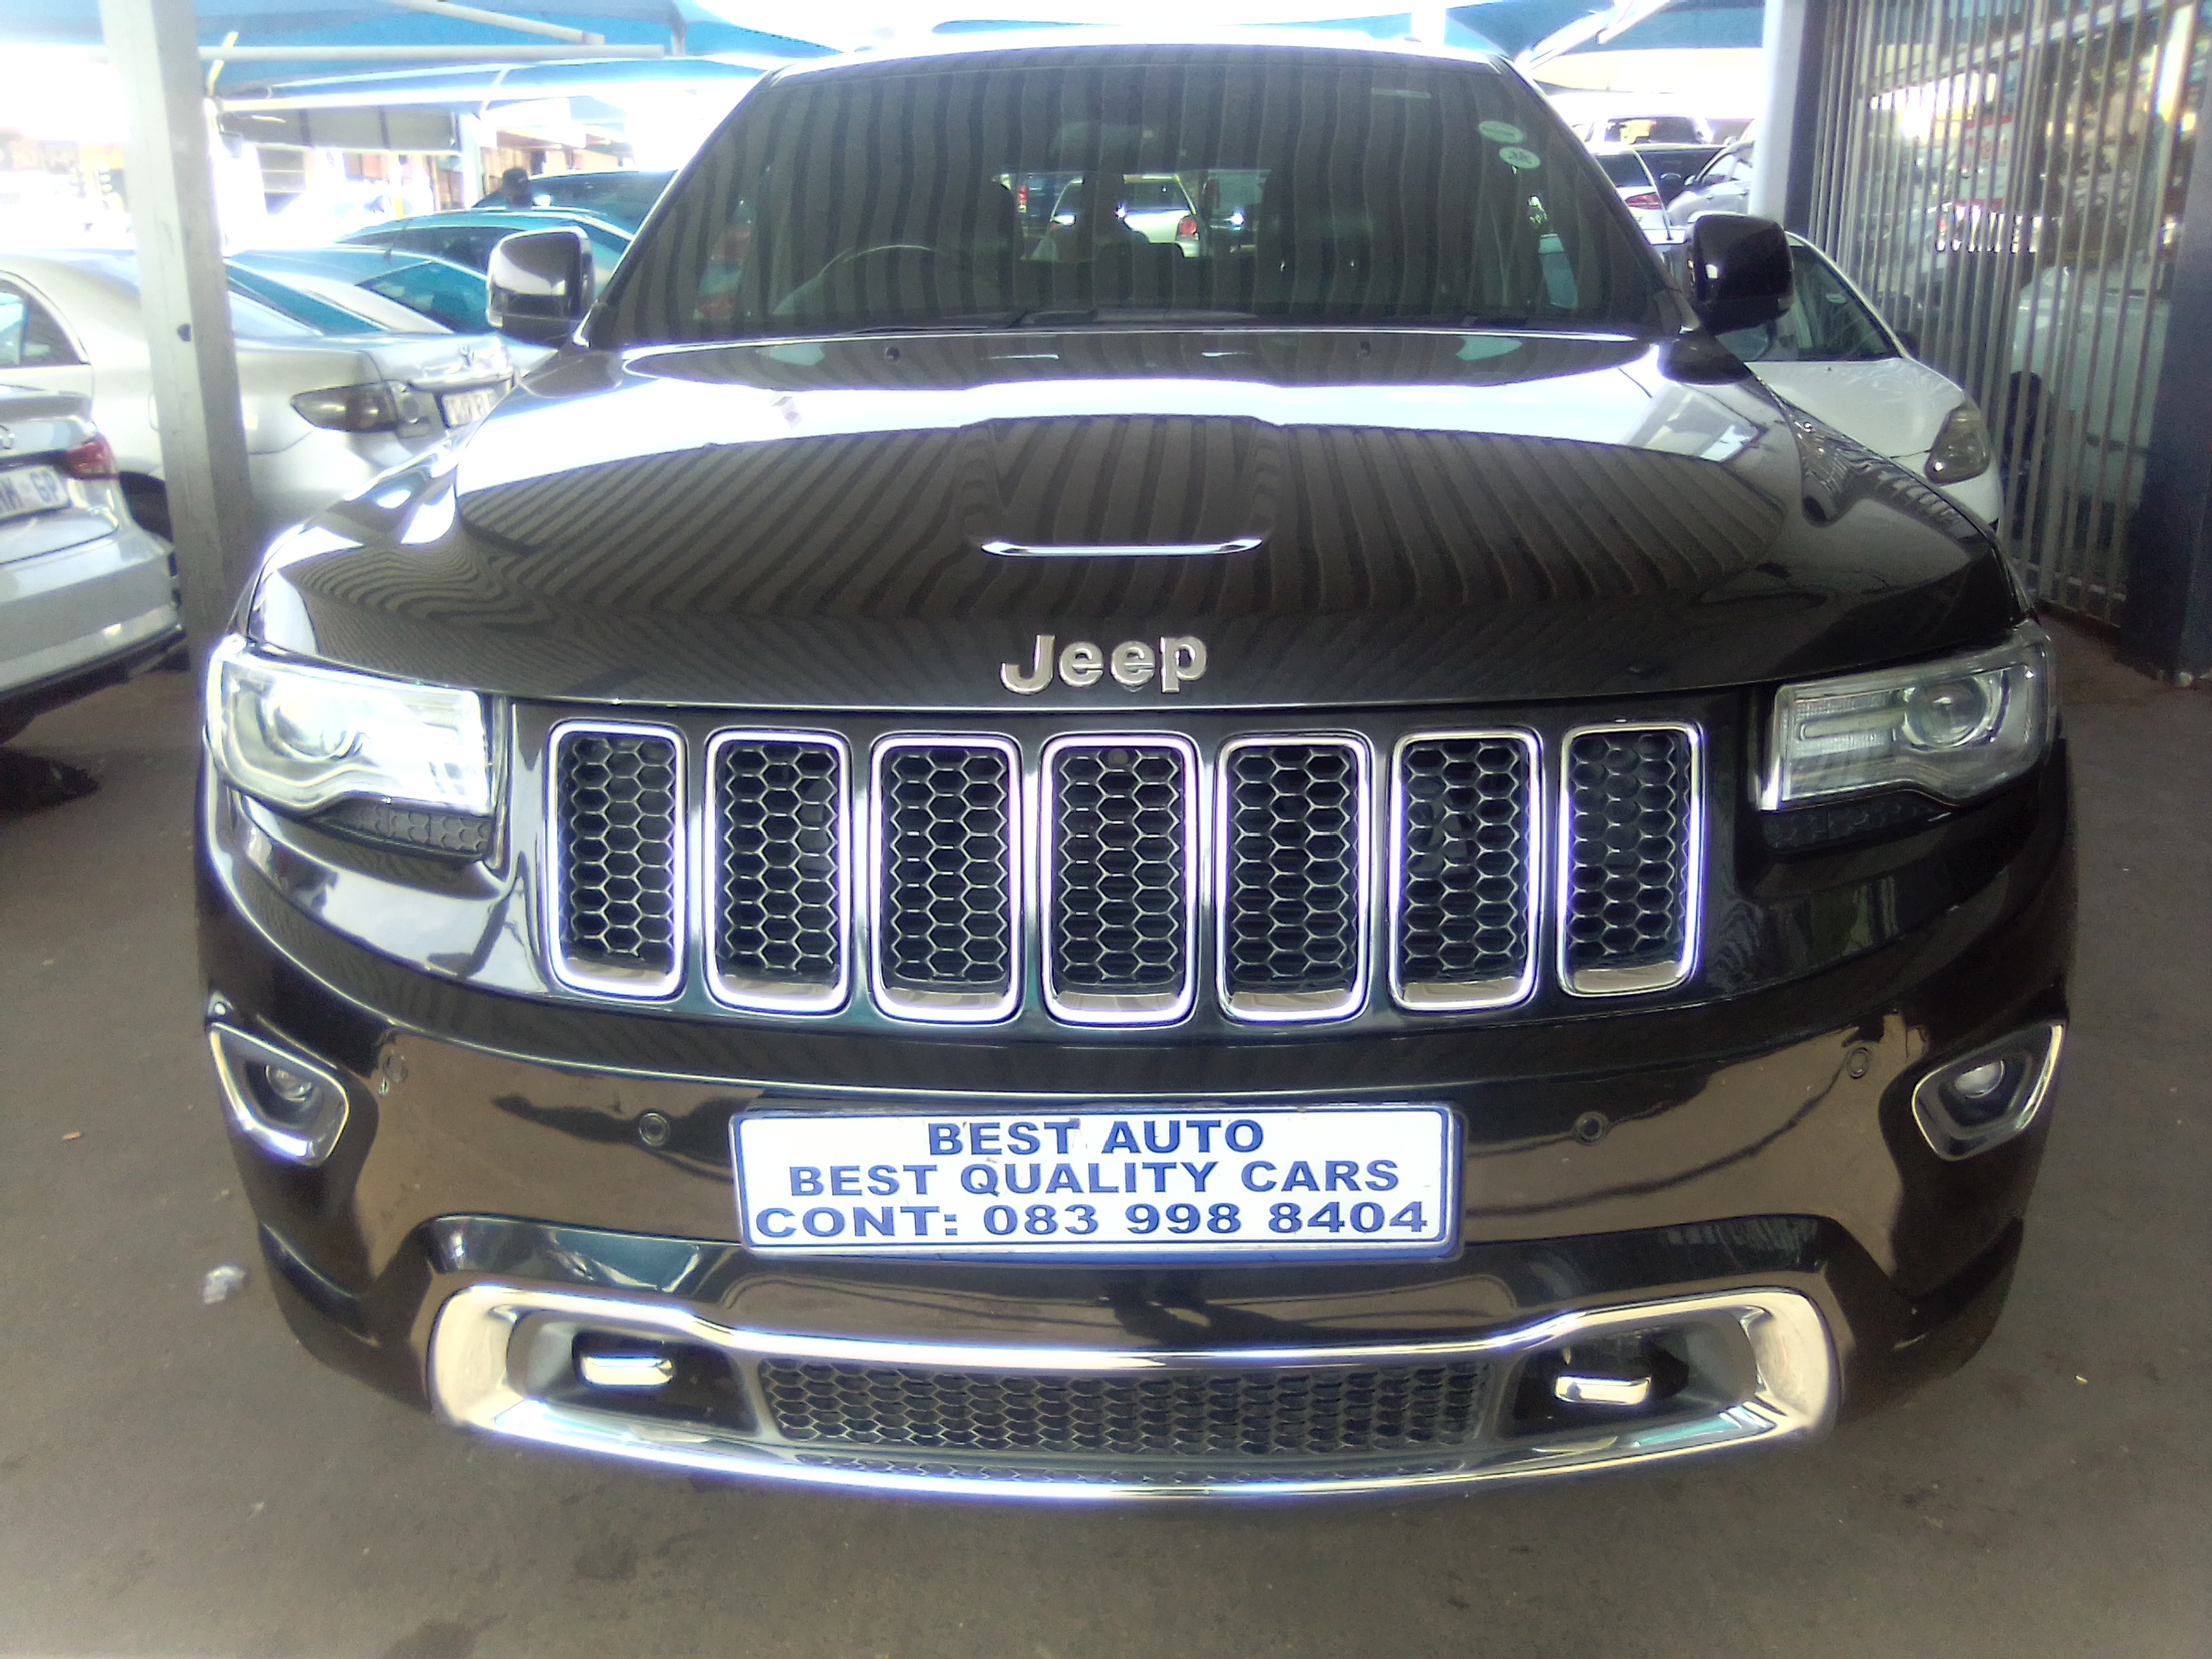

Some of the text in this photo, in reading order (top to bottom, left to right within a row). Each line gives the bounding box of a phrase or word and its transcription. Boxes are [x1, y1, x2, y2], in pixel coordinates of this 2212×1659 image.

[1000, 634, 1208, 695] Jeep
[928, 1118, 1264, 1156] BEST AUTO
[789, 1160, 1400, 1197] BEST QUALITY CARS
[755, 1201, 1427, 1238] CONT: 083 998 8404
